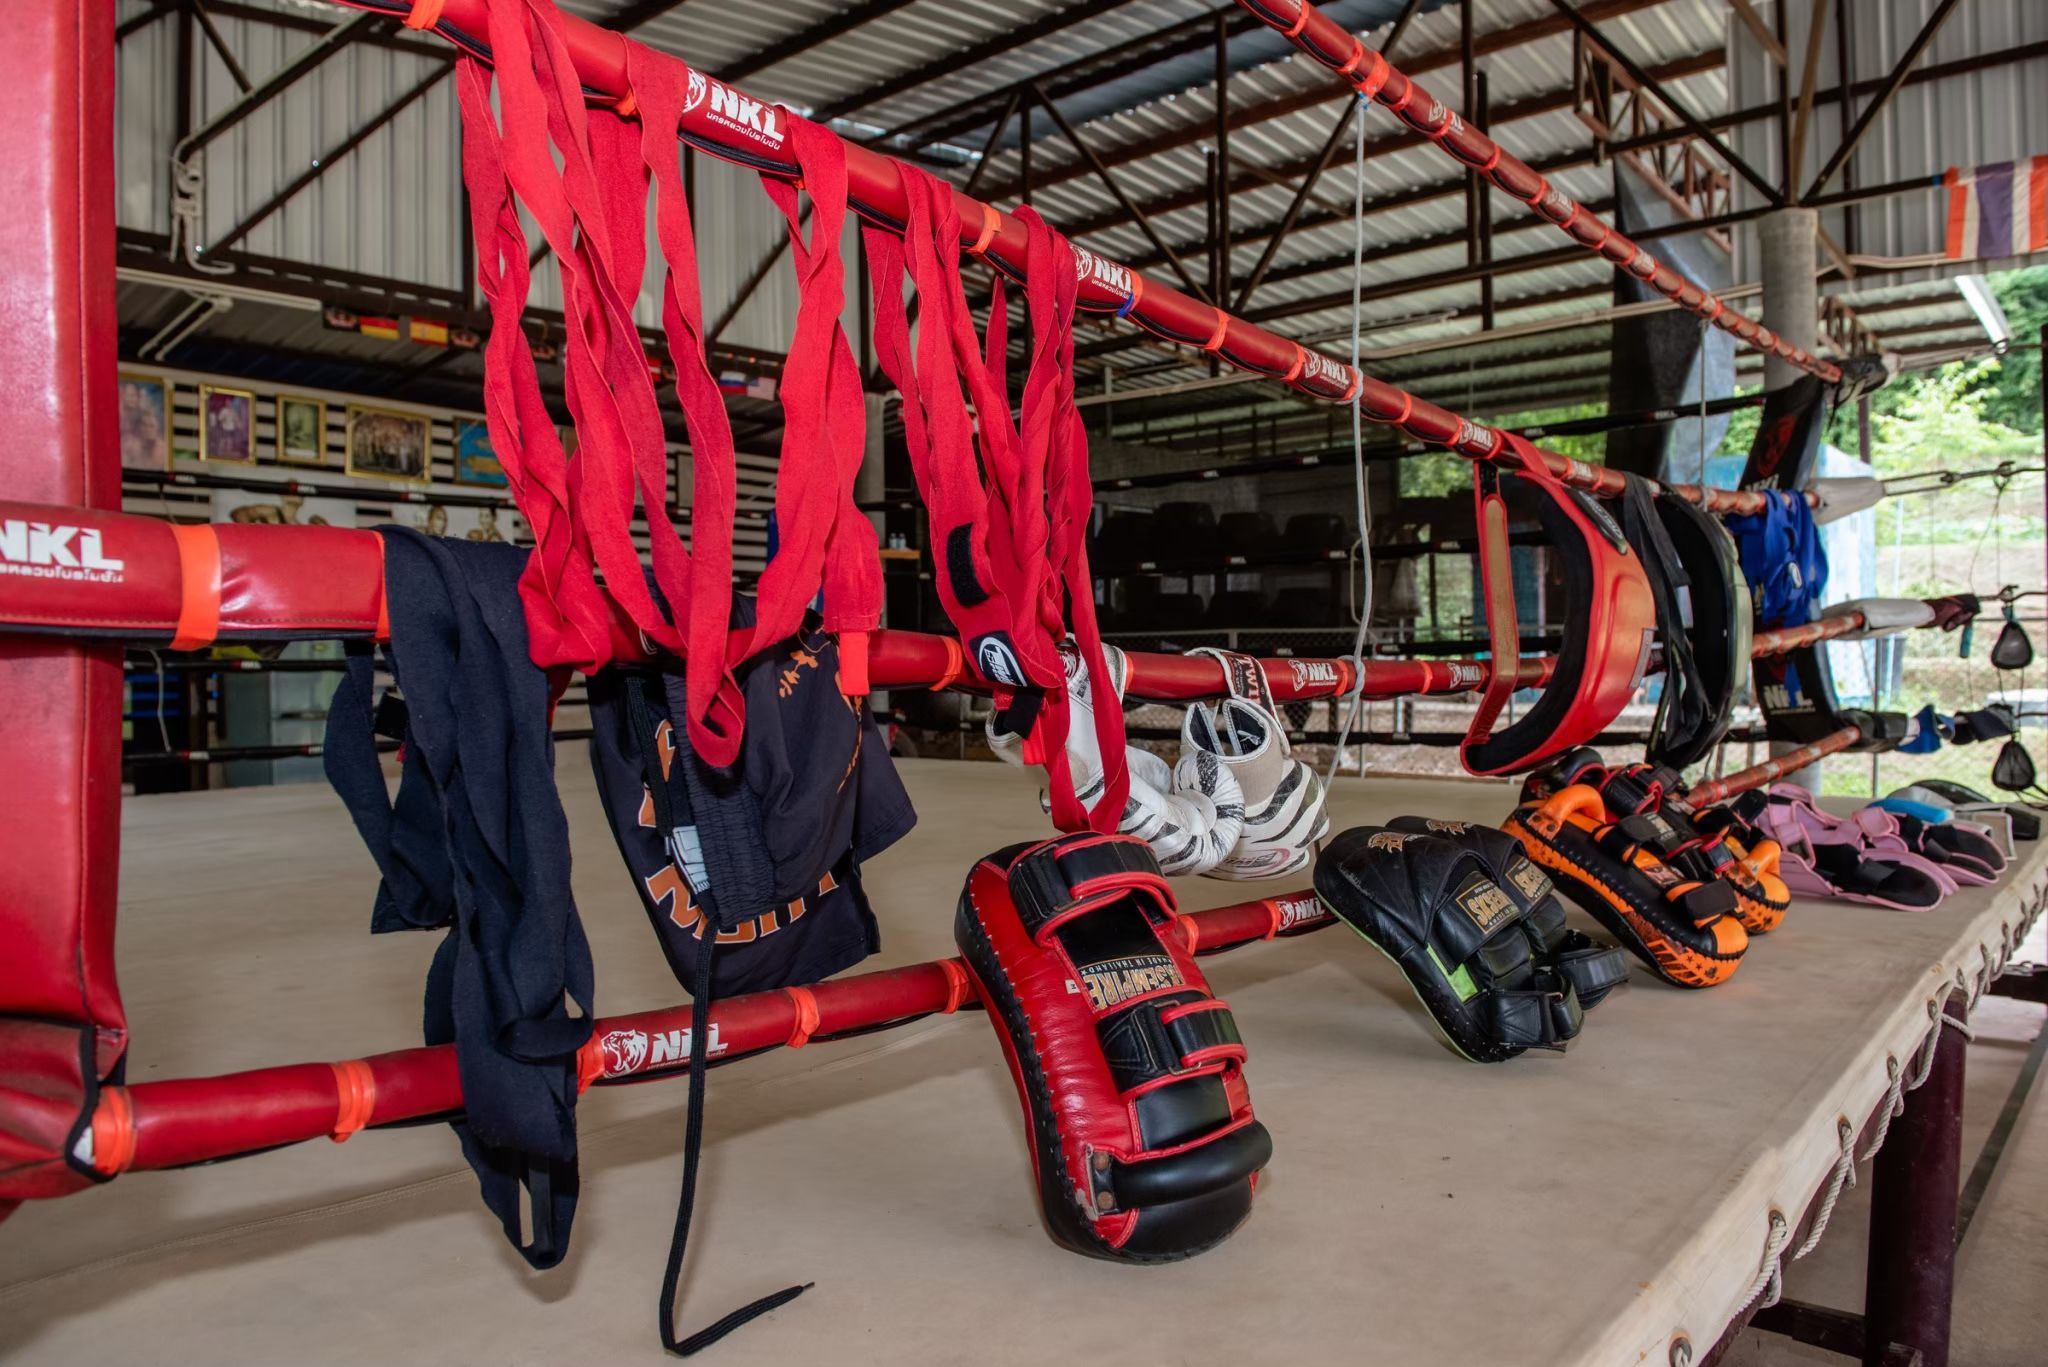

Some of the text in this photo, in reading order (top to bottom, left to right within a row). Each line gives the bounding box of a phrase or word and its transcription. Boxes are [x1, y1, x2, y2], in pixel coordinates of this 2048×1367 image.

[710, 81, 785, 143] NKL
[1308, 662, 1338, 681] NKL
[1295, 897, 1326, 920] NKL
